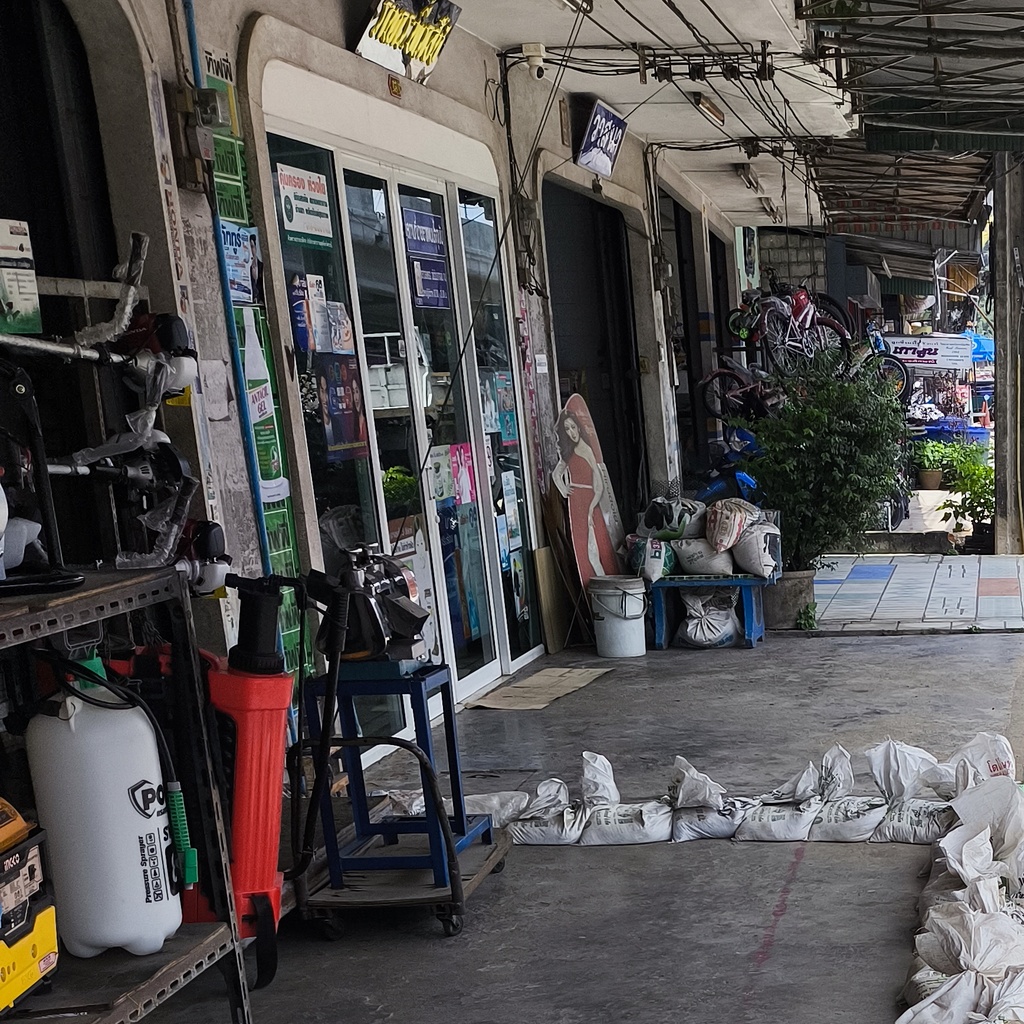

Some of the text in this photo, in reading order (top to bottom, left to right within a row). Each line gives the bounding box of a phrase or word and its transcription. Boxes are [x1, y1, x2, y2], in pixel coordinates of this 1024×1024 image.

[257, 400, 267, 415] GEL
[601, 467, 619, 524] Hirudoid
[138, 835, 153, 904] Pressure Sprayer
